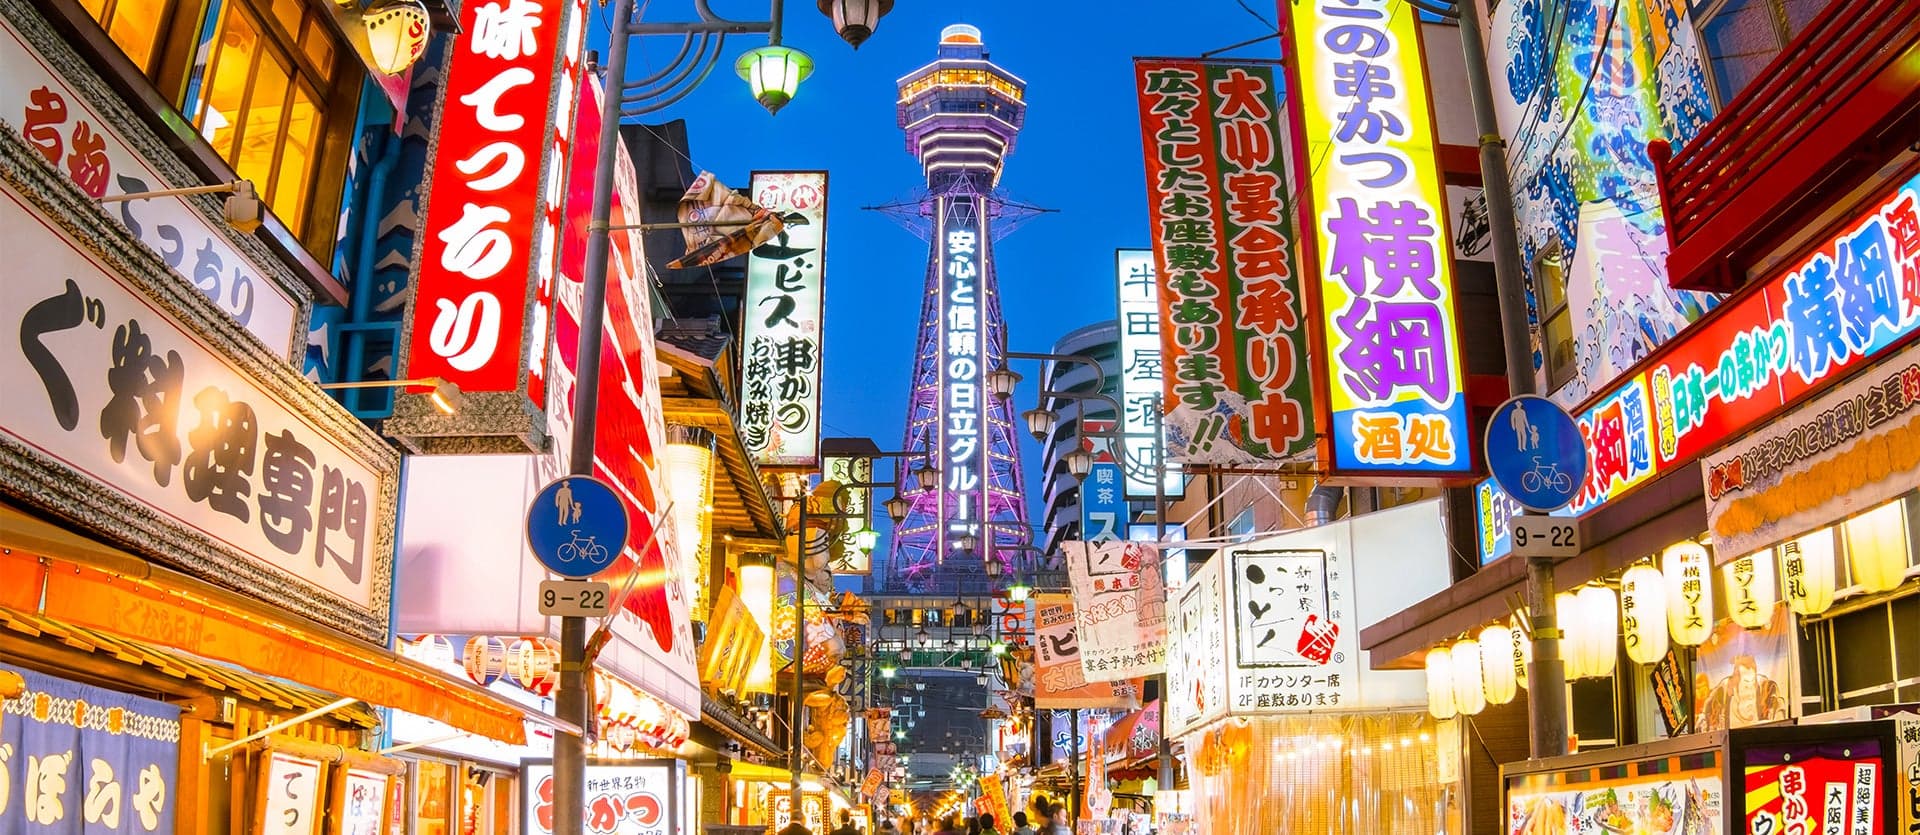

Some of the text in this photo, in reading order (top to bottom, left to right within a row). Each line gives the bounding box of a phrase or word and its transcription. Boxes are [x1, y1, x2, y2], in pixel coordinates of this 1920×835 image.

[1322, 0, 1407, 188] 一の串かつ
[1215, 70, 1301, 454] 大小宴会承り中
[1328, 197, 1449, 401] 横綱
[1788, 220, 1899, 378] 横綱
[745, 339, 771, 447] お好み焼き
[775, 337, 816, 432] 串かつ
[1674, 324, 1787, 432] 日本一の串かつ
[20, 279, 366, 585] ぐ料理専門
[1357, 416, 1453, 461] 酒処
[1623, 388, 1649, 476] 酒処
[1096, 468, 1114, 504] 喫茶
[1239, 692, 1341, 707] 2F 座敷あります
[1240, 674, 1340, 689] 1F カウンター席
[587, 776, 646, 791] 新世界名物
